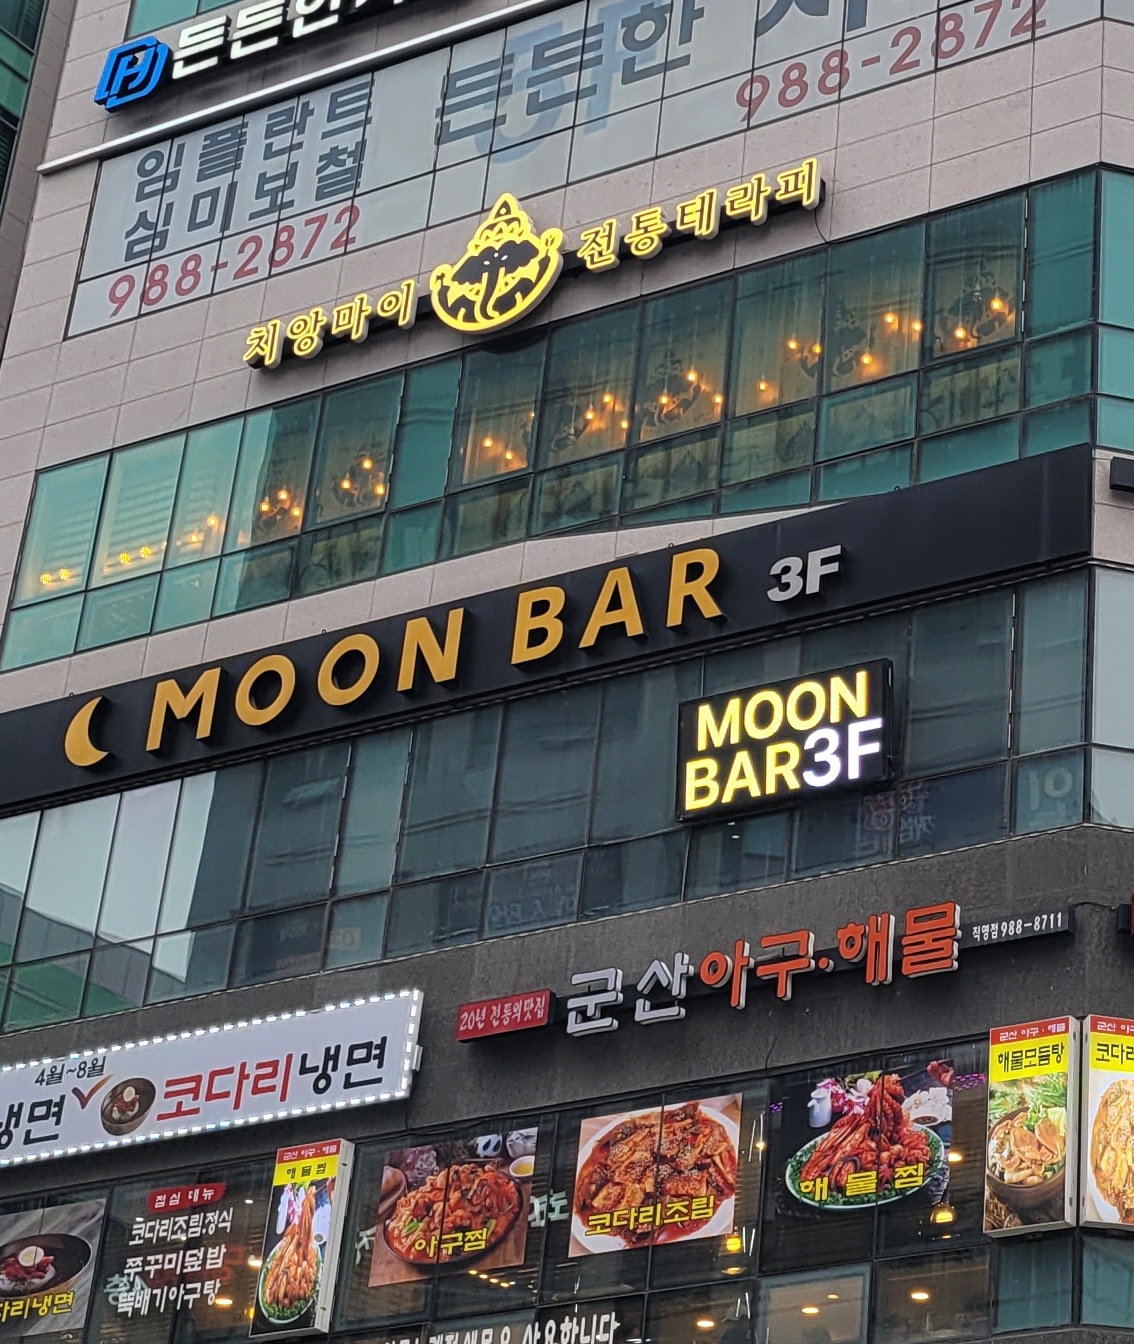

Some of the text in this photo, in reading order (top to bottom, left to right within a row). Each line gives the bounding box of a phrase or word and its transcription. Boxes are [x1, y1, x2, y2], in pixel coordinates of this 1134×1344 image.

[136, 72, 374, 195] 임플란트
[124, 142, 366, 263] 심미보철
[107, 204, 361, 317] 988-2872
[243, 157, 821, 366] 치앙마이 전통테라피
[146, 545, 842, 752] MOON BAR 3F
[696, 670, 869, 753] MOON
[458, 1008, 486, 1032] 20년
[566, 952, 694, 1036] 군산
[972, 922, 999, 941] 직영점
[1000, 912, 1063, 937] 988-8711
[35, 1057, 107, 1087] 4월~8월
[156, 1036, 388, 1122] 코다리냉면
[585, 1194, 715, 1237] 코다리조림
[799, 1162, 926, 1202] 해물찜
[414, 1227, 489, 1259] 아구찜
[117, 1278, 223, 1318] 뚝배기아구탕
